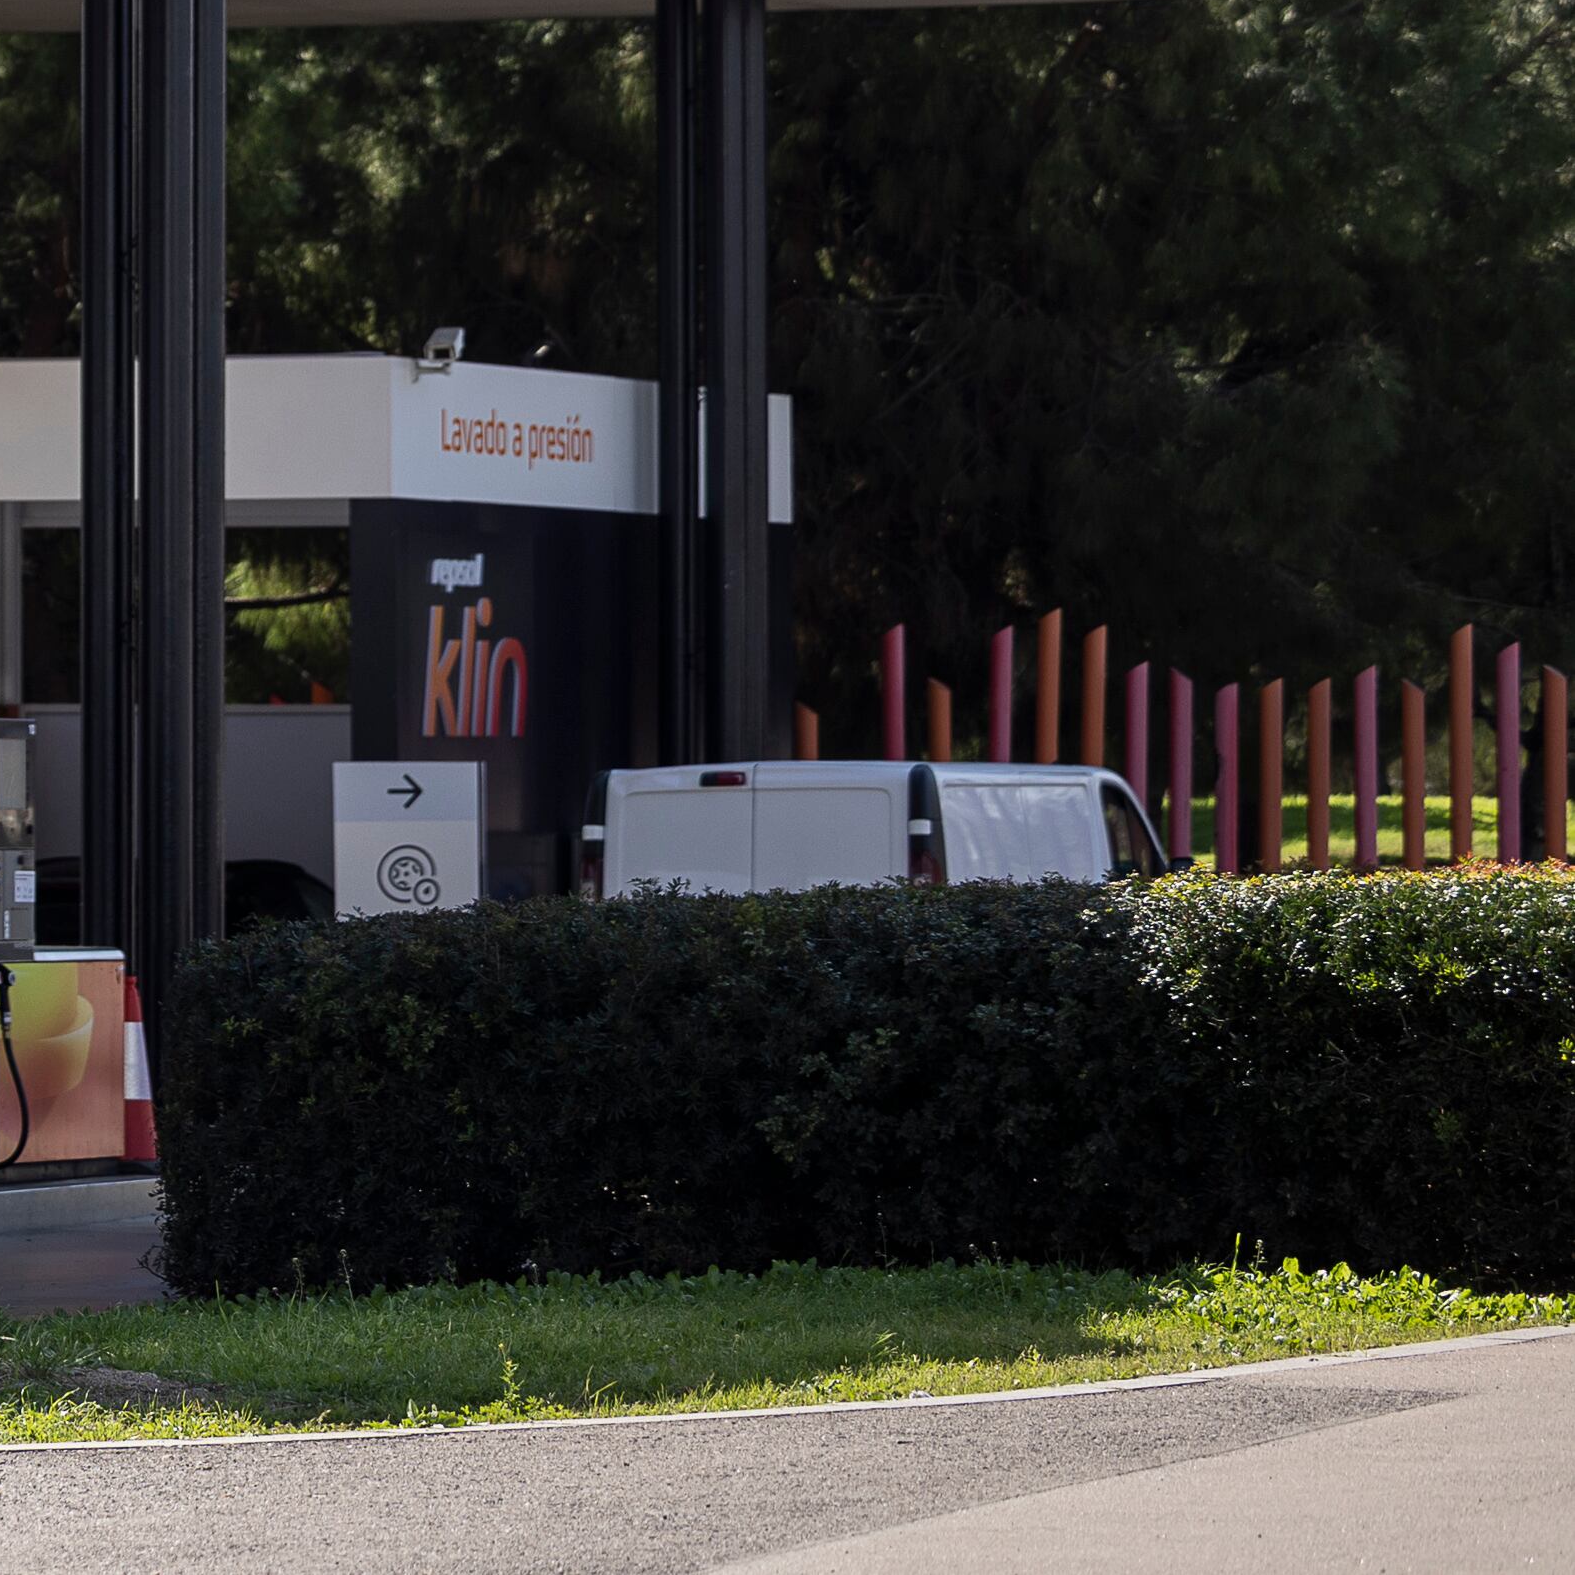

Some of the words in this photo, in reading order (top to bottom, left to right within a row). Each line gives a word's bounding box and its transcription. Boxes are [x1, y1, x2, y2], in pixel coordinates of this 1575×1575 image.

[441, 408, 507, 456] Lavado
[513, 423, 523, 457] a
[528, 415, 593, 470] presión
[422, 597, 528, 737] klin
